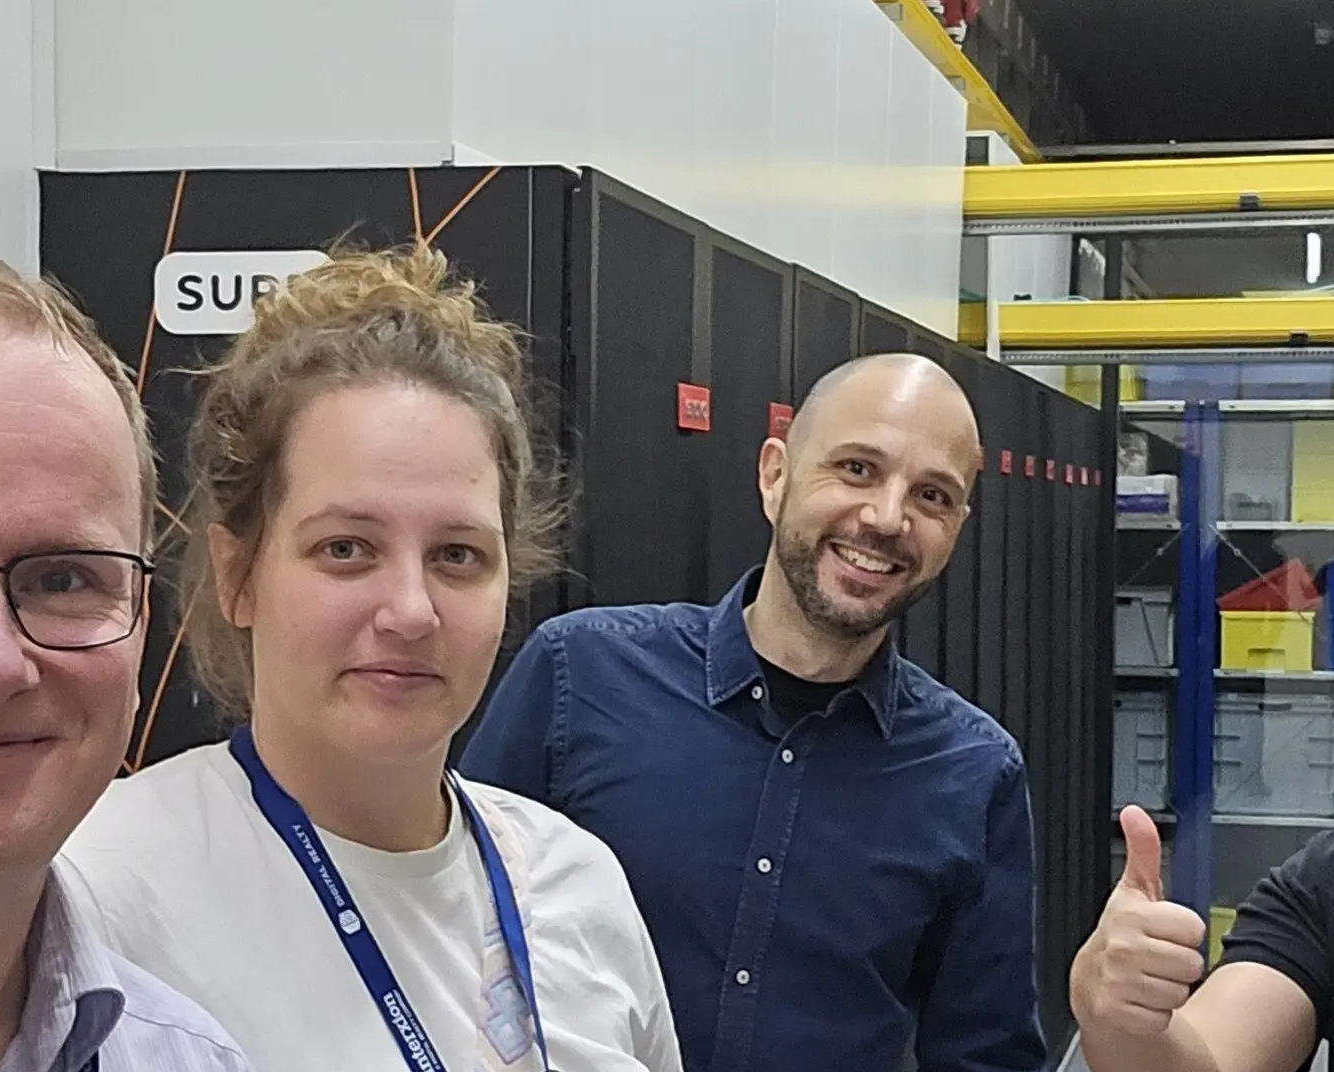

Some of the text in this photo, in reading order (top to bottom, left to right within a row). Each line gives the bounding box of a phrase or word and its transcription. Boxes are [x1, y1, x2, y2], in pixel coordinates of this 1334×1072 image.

[176, 274, 301, 311] SUR
[291, 824, 346, 908] DIGITAL REALTY
